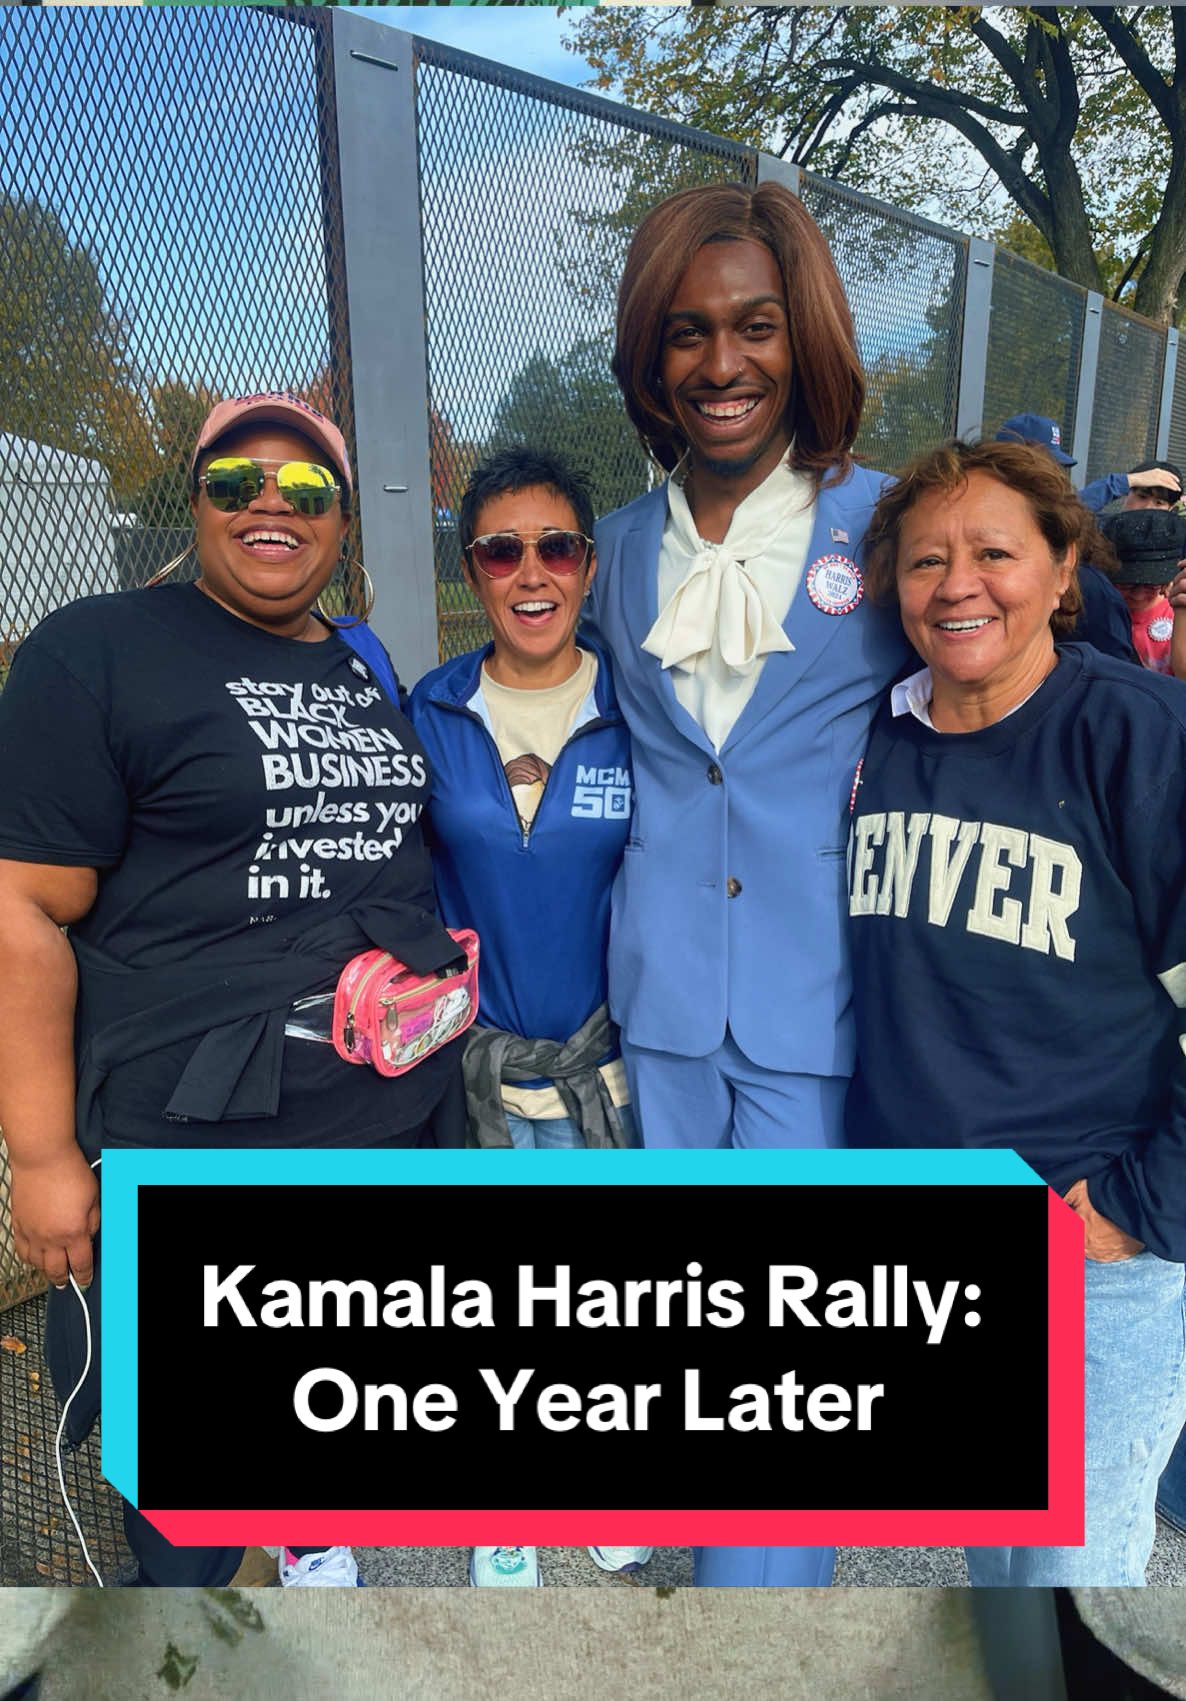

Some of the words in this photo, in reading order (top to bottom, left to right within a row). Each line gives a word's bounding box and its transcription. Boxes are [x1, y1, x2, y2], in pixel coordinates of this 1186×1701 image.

[825, 569, 852, 586] HARRIS
[826, 581, 848, 594] WALZ
[225, 677, 303, 705] stay
[311, 683, 356, 707] out
[236, 697, 360, 729] BLACK
[248, 720, 403, 753] WOMEN
[261, 753, 426, 790] BUSINESS
[575, 764, 631, 786] MCM
[266, 791, 370, 828] unless
[375, 802, 423, 833] you
[571, 785, 631, 819] 50
[254, 828, 403, 861] invested
[248, 865, 289, 899] in
[299, 863, 332, 899] it.
[847, 811, 1083, 962] ENVER
